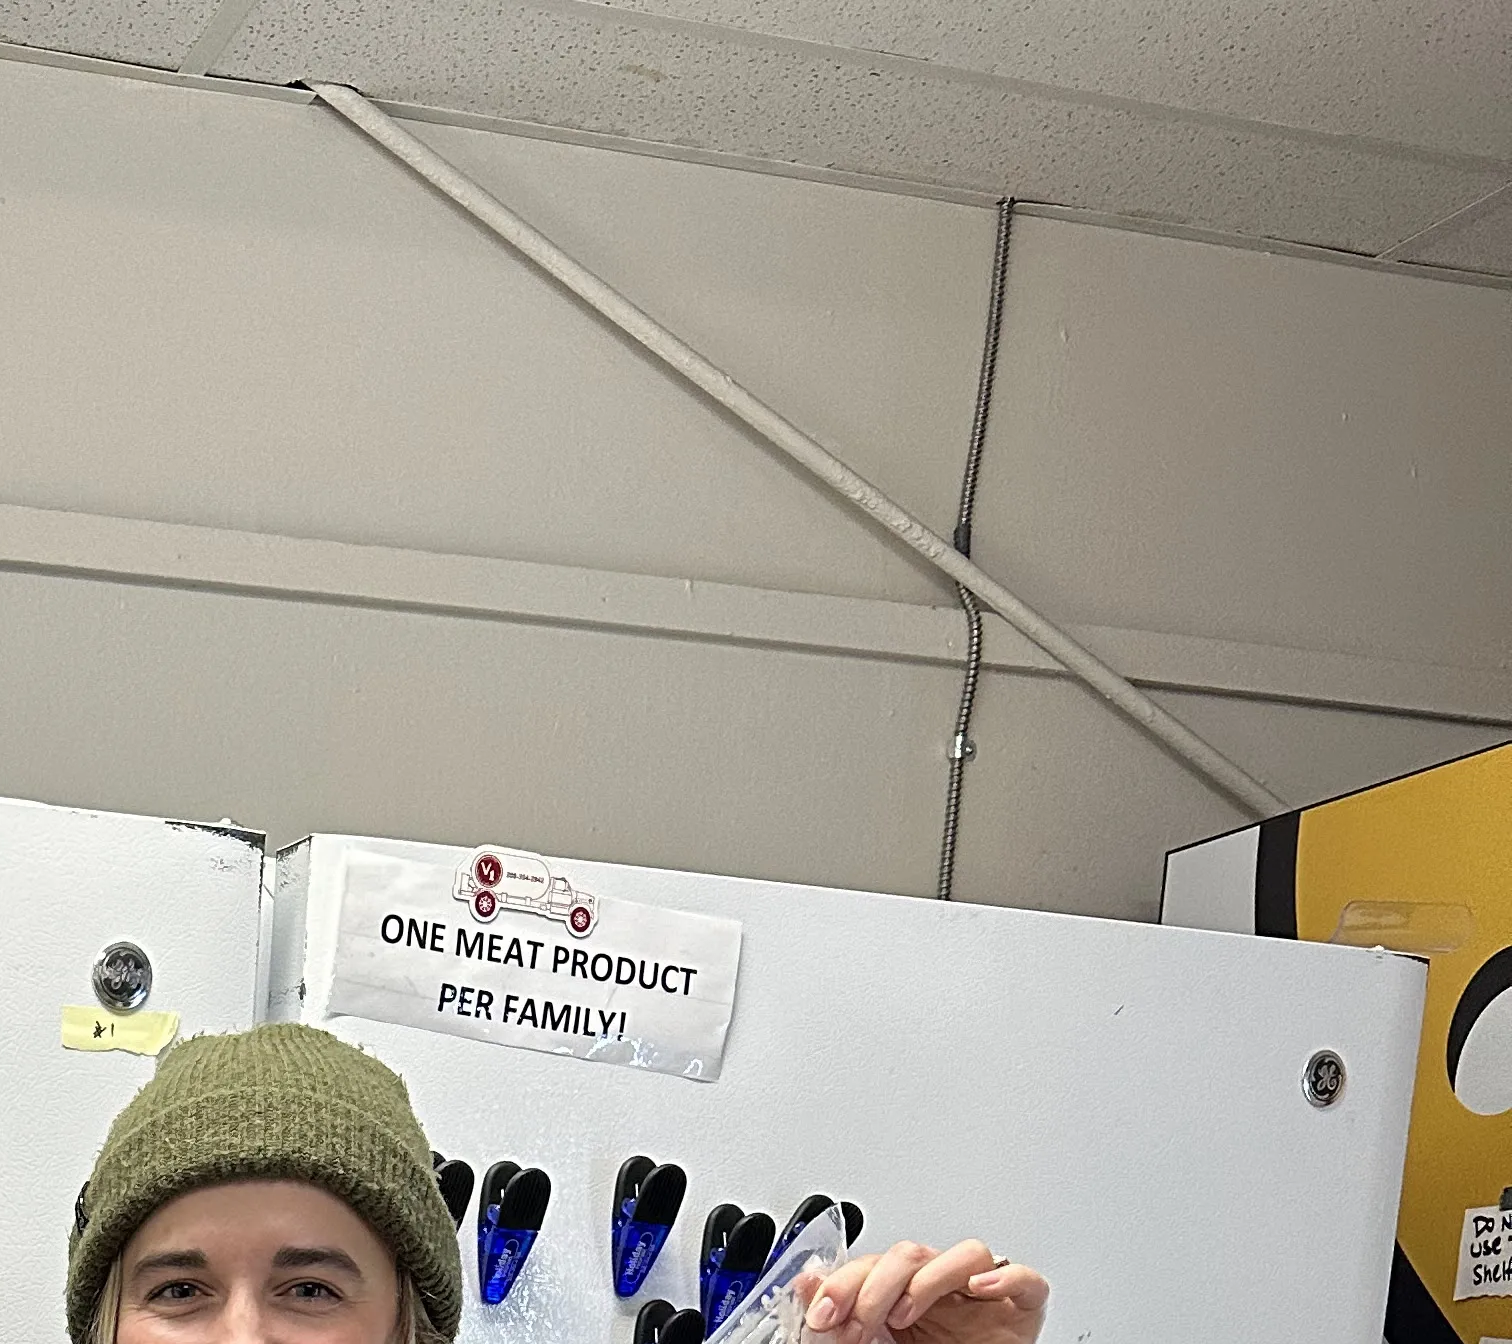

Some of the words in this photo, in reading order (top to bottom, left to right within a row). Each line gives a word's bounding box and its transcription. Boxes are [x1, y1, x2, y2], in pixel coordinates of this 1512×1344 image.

[380, 914, 447, 953] ONE
[454, 928, 545, 970] MEAT
[551, 945, 698, 996] PRODUCT
[437, 983, 494, 1021] PER
[502, 995, 627, 1041] FAMILY!
